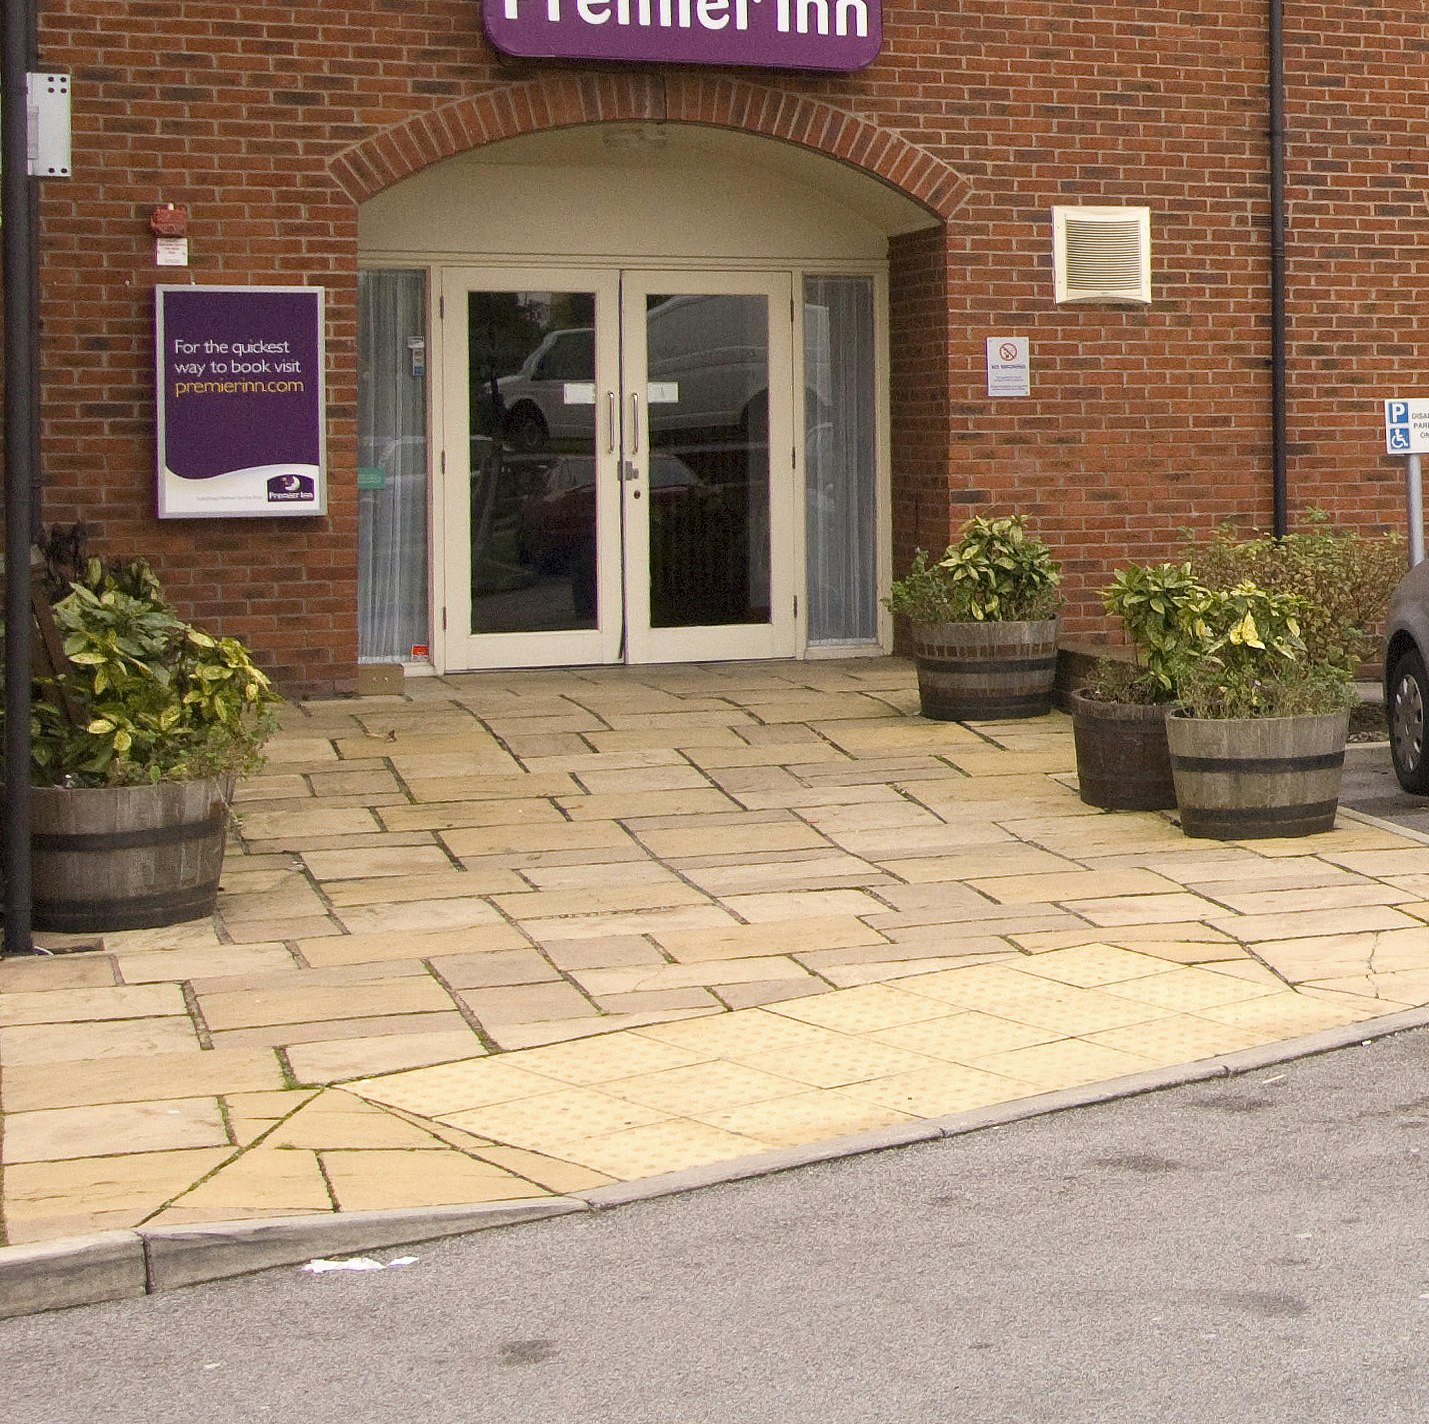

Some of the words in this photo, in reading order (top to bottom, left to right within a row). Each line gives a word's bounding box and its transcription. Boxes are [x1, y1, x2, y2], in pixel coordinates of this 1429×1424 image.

[174, 339, 200, 354] For
[204, 339, 229, 354] the
[232, 339, 290, 357] quickest
[174, 363, 206, 376] way
[211, 361, 227, 374] to
[231, 359, 271, 374] book
[274, 359, 302, 374] visit
[175, 377, 305, 398] premierinn.com
[1391, 403, 1406, 423] P
